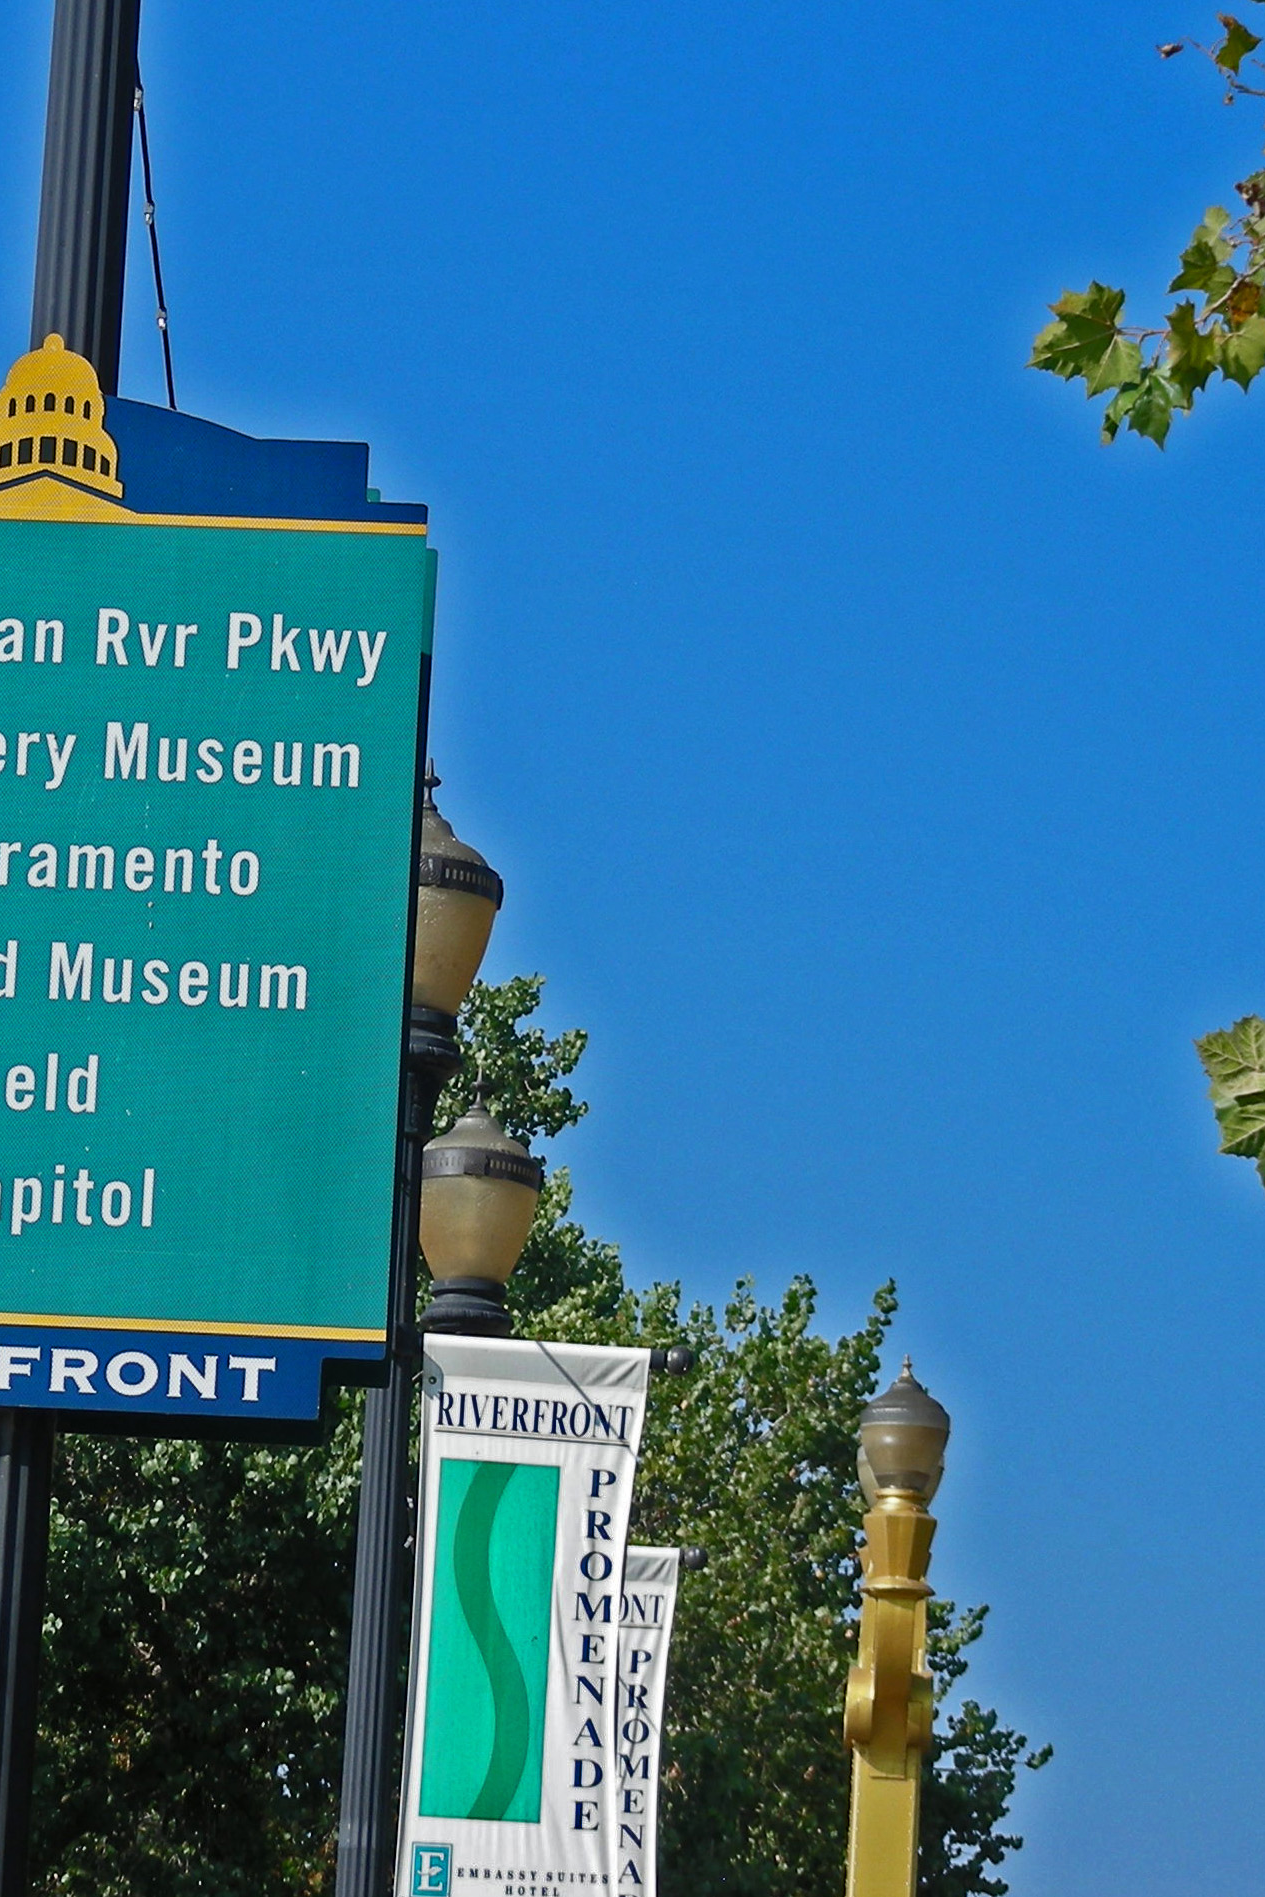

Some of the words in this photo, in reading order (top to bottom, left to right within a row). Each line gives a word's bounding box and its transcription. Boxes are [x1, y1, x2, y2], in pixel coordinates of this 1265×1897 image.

[96, 606, 198, 668] Rvr
[227, 612, 387, 687] Pkwy
[104, 721, 360, 788] Museum
[48, 941, 308, 1010] Museum
[437, 1391, 633, 1441] RIVERFRONT
[570, 1468, 617, 1831] PROMENADE
[618, 1649, 653, 1897] PROMENA
[457, 1867, 537, 1882] EMBASSY
[546, 1869, 610, 1885] SUITES
[504, 1885, 561, 1897] HOTEL
